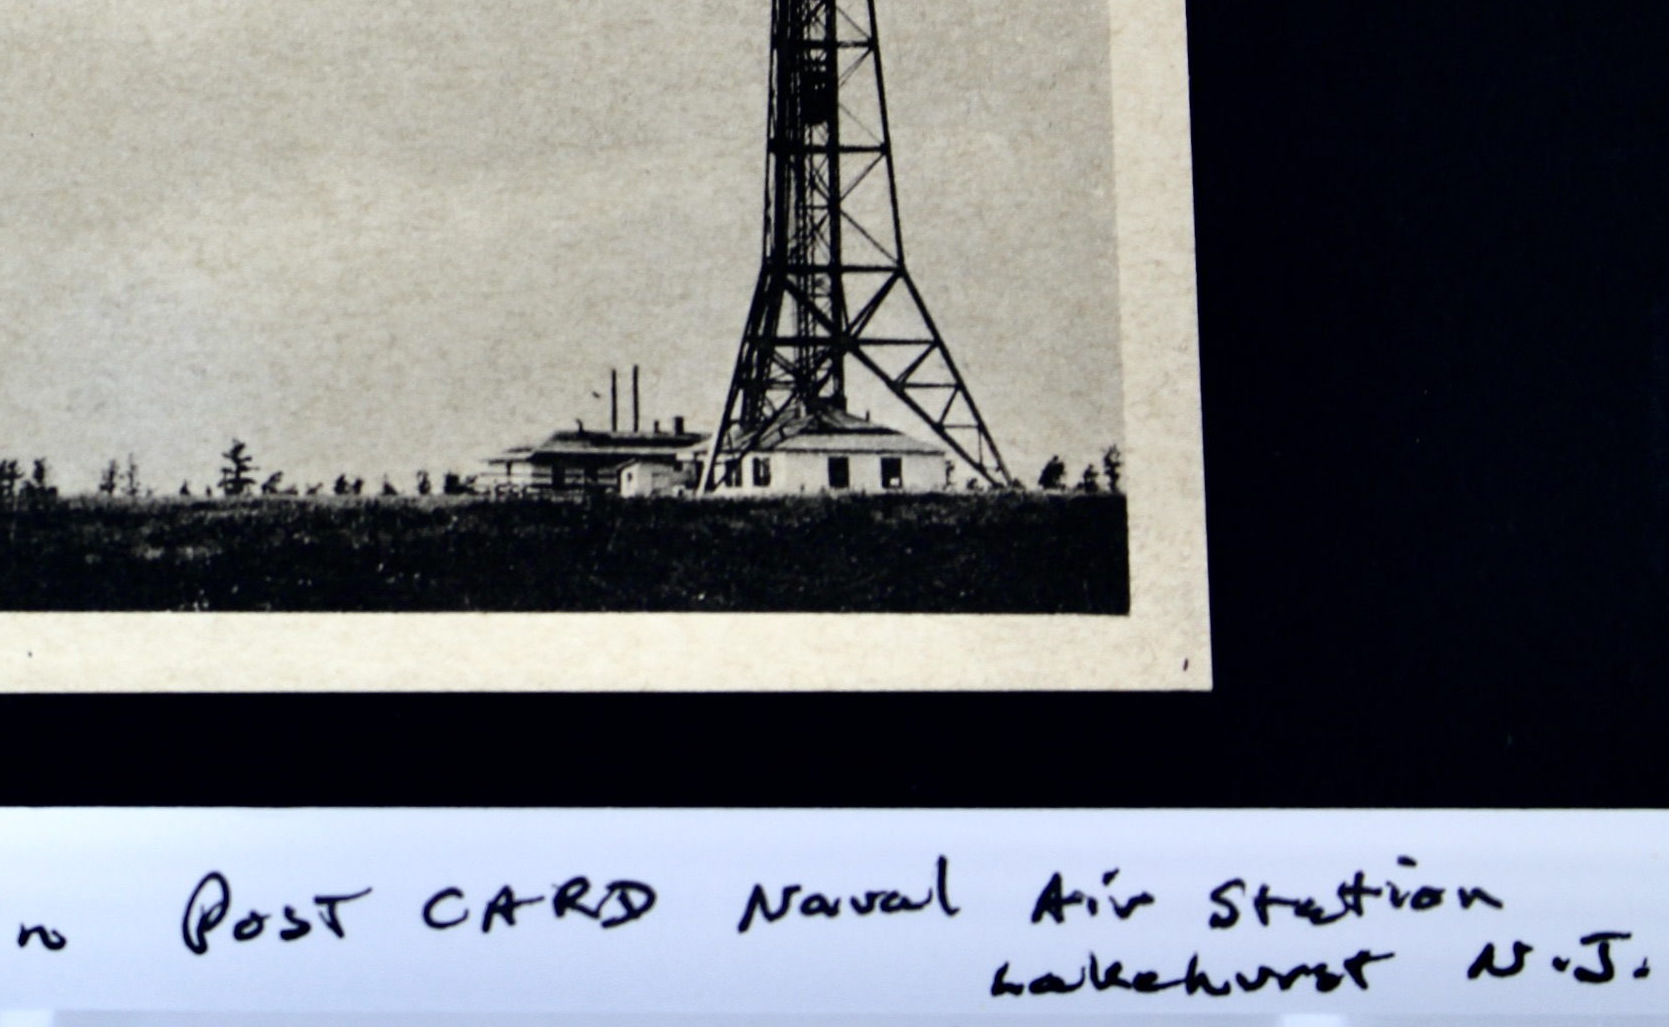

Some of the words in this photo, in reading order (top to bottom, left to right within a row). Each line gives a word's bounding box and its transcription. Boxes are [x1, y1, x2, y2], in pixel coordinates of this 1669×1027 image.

[422, 876, 657, 934] CARD
[737, 855, 961, 934] Naval
[1030, 869, 1156, 924] Air
[1209, 856, 1504, 929] Station
